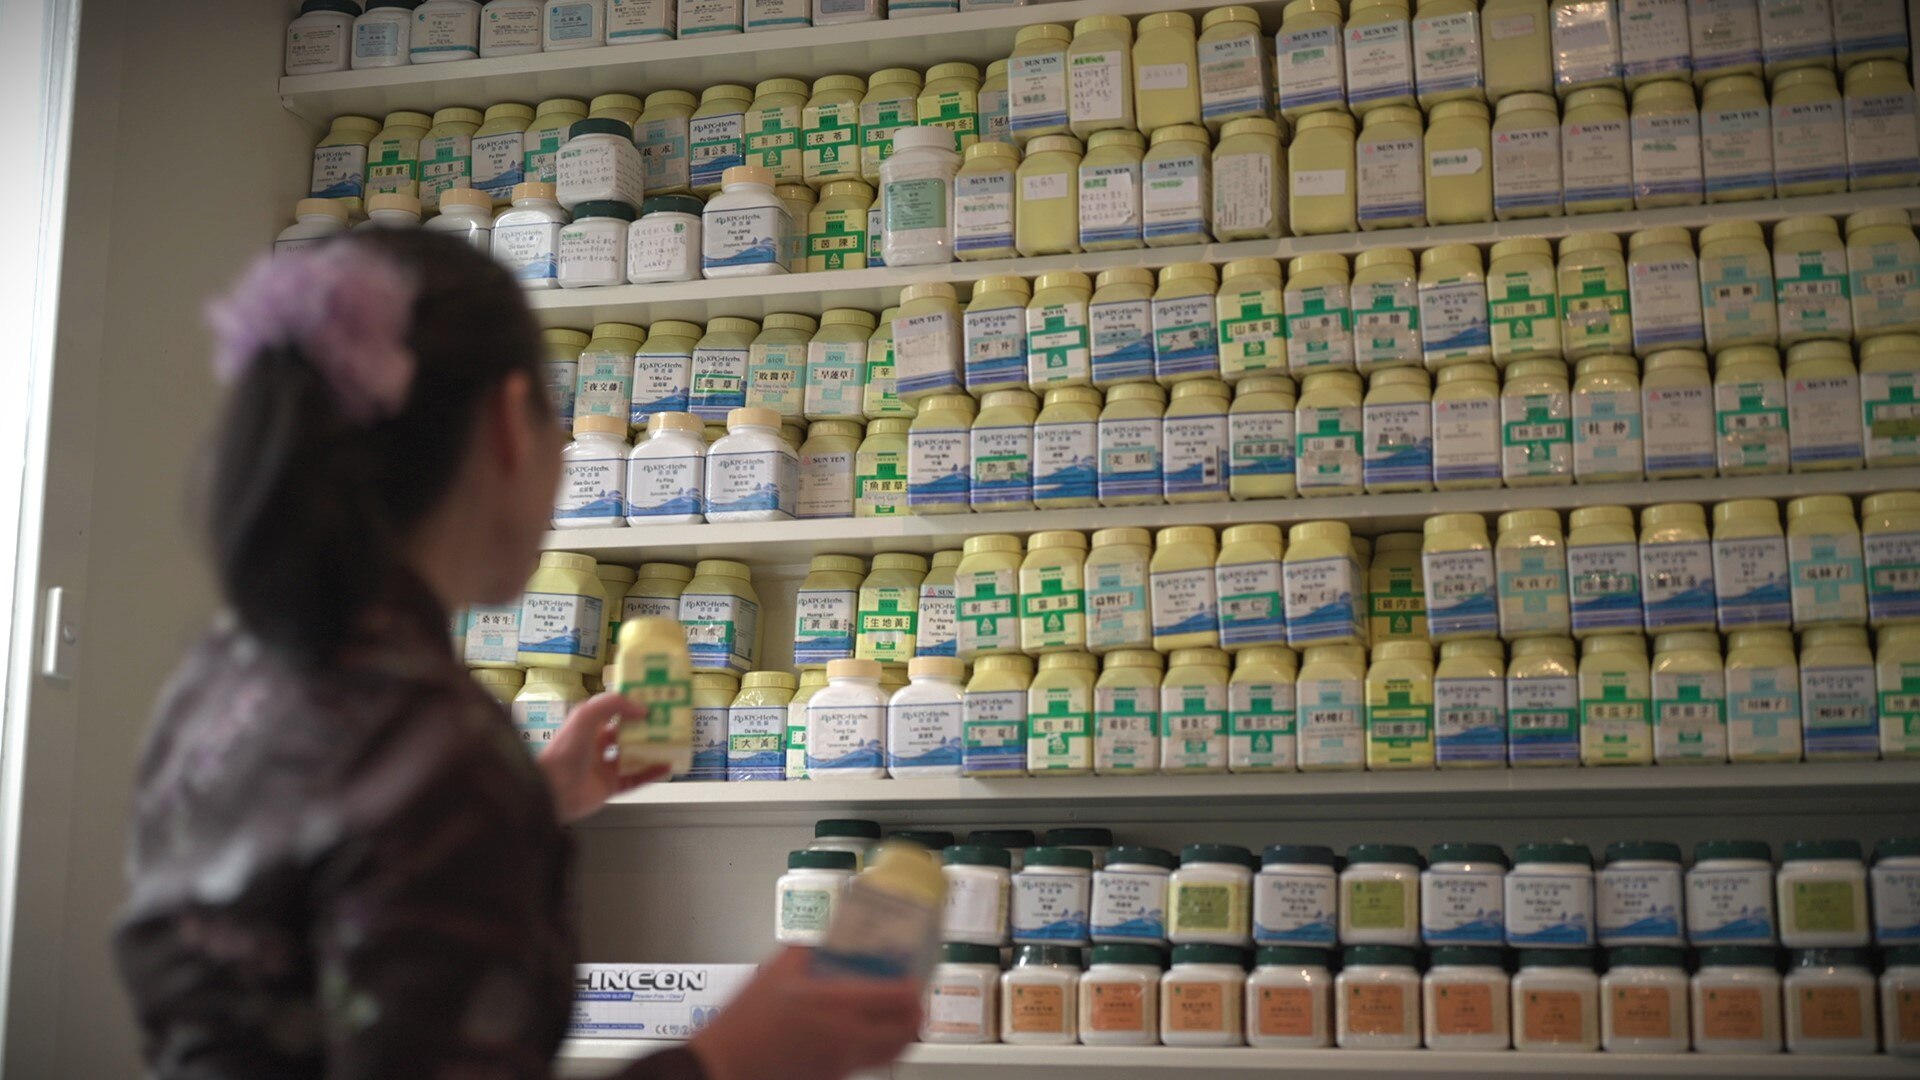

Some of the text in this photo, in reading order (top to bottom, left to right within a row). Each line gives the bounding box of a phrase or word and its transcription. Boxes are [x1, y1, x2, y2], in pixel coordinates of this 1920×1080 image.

[1432, 17, 1467, 28] SUN TEN
[1363, 25, 1398, 37] SUN TEN
[1292, 30, 1329, 43] SUN TEN
[1215, 40, 1251, 52] SUN TEN
[1024, 56, 1057, 67] SUN TEN
[1792, 104, 1832, 115] SUN TEN
[1720, 112, 1760, 123] SUN TEN
[1582, 123, 1621, 133] SUN TEN
[815, 131, 842, 143] 茯苓
[1510, 131, 1548, 141] SUN TEN
[1377, 142, 1414, 152] SUN TEN
[1158, 160, 1194, 170] SUN TEN
[1095, 167, 1131, 177] SUN TEN
[970, 176, 1004, 186] SUN TEN
[1649, 262, 1688, 272] SUN TEN
[909, 314, 943, 326] SUN TEN
[759, 371, 789, 381] 敗醬草
[820, 369, 849, 379] 旱蓮草
[589, 383, 618, 392] 夜交藤
[1807, 379, 1848, 389] SUN TEN
[1662, 389, 1702, 399] SUN TEN
[1450, 400, 1488, 411] SUN TEN
[812, 456, 828, 464] SUN
[869, 481, 903, 491] 魚腥草
[938, 589, 953, 597] SUN
[481, 615, 511, 625] 桑寄生
[870, 618, 903, 628] 生地黃
[523, 731, 551, 741] 桑枝
[742, 738, 770, 749] 大黃
